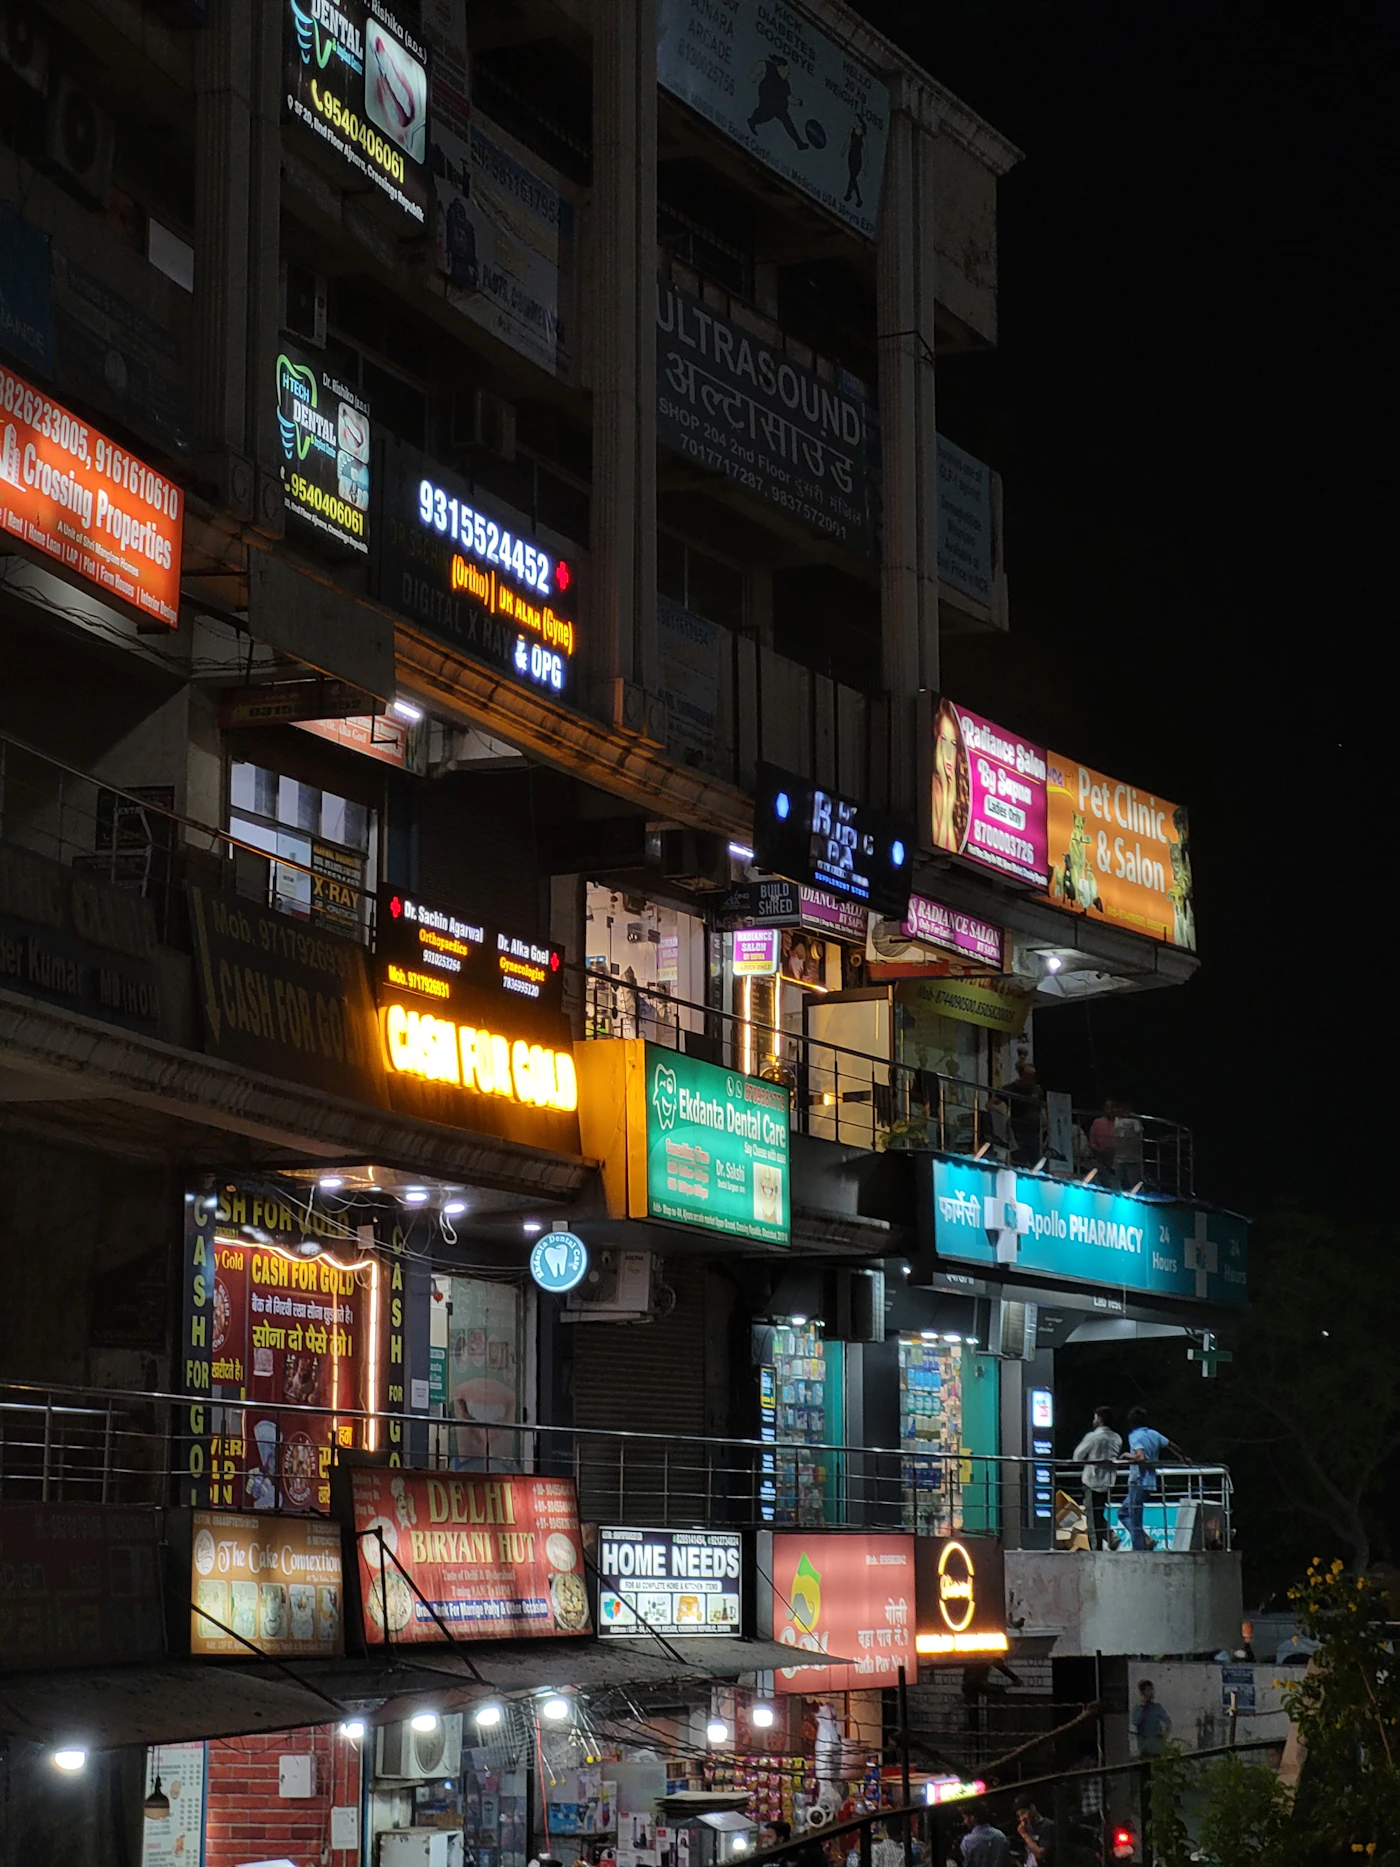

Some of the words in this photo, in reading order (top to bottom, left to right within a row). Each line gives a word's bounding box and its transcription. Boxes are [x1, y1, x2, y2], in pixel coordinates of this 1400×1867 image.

[312, 0, 363, 58] DENTAL
[756, 21, 816, 76] GOODBYE
[758, 5, 816, 60] DIABETES
[825, 77, 860, 111] WEIGHT
[842, 61, 871, 90] HELLO
[323, 91, 404, 184] 9540406061
[657, 289, 860, 447] ULTRASOUND
[293, 399, 336, 447] DENTAL
[660, 398, 700, 430] SHOP
[704, 423, 727, 446] 204
[731, 440, 755, 464] 2nd
[758, 453, 791, 485] Floor
[95, 439, 178, 520] 9161610610
[23, 443, 93, 529] Crossing
[96, 489, 171, 570] Properties
[291, 473, 363, 537] 9540406061
[419, 480, 551, 595] 9315524452
[451, 553, 490, 607] (Ortho)
[542, 606, 573, 656] (Gyne)
[403, 572, 462, 634] DIGITAL
[468, 609, 478, 641] X
[482, 618, 512, 660] RAY
[530, 645, 563, 690] OPG
[961, 716, 1016, 766] Radiance
[1016, 743, 1047, 782] Salon
[977, 758, 997, 792] By
[1078, 766, 1110, 822] Pet
[1113, 784, 1165, 850] Clinic
[1097, 830, 1112, 875] &
[1114, 837, 1165, 900] Salon
[759, 899, 792, 916] SHRED
[760, 883, 789, 898] BUILD
[212, 900, 256, 946] Mob.
[404, 901, 417, 920] Dr.
[418, 906, 448, 931] Sachin
[449, 917, 484, 943] Agarwal
[918, 899, 969, 934] RADIANCE
[969, 922, 1001, 948] SALON
[498, 934, 509, 953] Dr.
[511, 939, 529, 959] Alka
[531, 945, 549, 966] Goel
[500, 956, 546, 982] Gynecologist
[741, 942, 766, 952] SALON
[388, 964, 408, 986] Mob.
[220, 958, 276, 1040] CASH
[275, 978, 316, 1054] FOR
[679, 1087, 724, 1132] Ekdanta
[727, 1101, 761, 1143] Dental
[763, 1113, 786, 1152] Care
[716, 1159, 726, 1178] Dr.
[220, 1190, 247, 1225] SH
[252, 1194, 293, 1232] FOR
[1027, 1208, 1067, 1244] Apollo
[1069, 1213, 1144, 1255] PHARMACY
[222, 1250, 244, 1275] Gold
[251, 1254, 290, 1291] CASH
[291, 1261, 317, 1293] FOR
[320, 1266, 355, 1300] GOLD
[533, 1239, 549, 1279] Ekdanta
[548, 1234, 577, 1250] Dental
[572, 1248, 581, 1271] Care
[1152, 1251, 1178, 1276] Hours
[252, 1318, 286, 1350] सोना
[288, 1322, 303, 1352] दो
[305, 1324, 328, 1356] पैसे
[186, 1360, 210, 1390] FOR
[426, 1478, 516, 1525] DELHI
[218, 1541, 246, 1573] The
[248, 1542, 278, 1574] Cake
[281, 1545, 341, 1575] Connextion
[410, 1530, 494, 1564] BIRYANI
[497, 1531, 536, 1564] HUT
[602, 1543, 667, 1576] HOME
[671, 1545, 740, 1578] NEEDS
[875, 1655, 889, 1673] Pav
